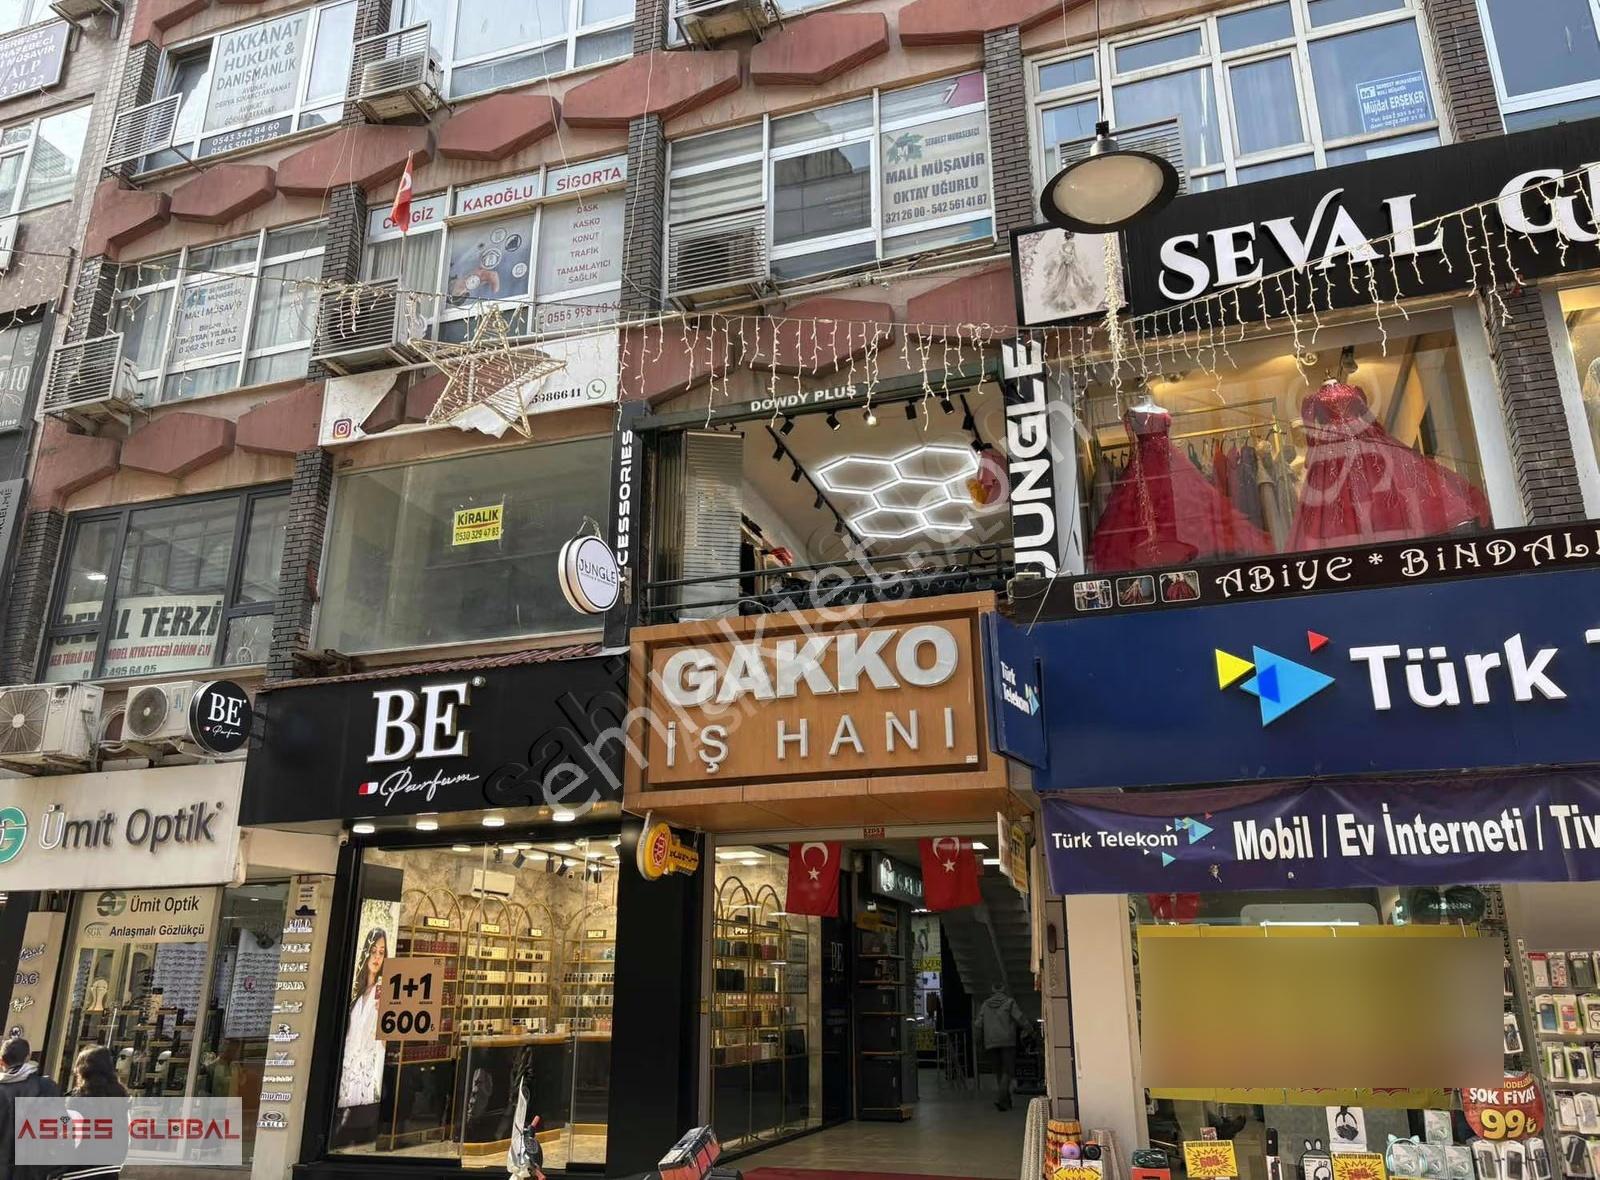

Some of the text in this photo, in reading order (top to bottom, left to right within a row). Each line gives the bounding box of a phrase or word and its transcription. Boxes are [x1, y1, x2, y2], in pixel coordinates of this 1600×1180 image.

[223, 19, 302, 56] AKKANAT
[224, 42, 295, 72] HUKUK &
[886, 152, 985, 185] MALİ MÜŞAVİR
[383, 167, 621, 229] CGİZ KAROĞLU SİGORTA
[893, 176, 978, 204] OKTAY UĞURLU
[573, 218, 600, 229] KASKO
[886, 212, 900, 223] 321
[901, 209, 912, 220] 26
[931, 202, 948, 214] 542
[570, 247, 599, 258] TRAFİK
[573, 232, 599, 244] KONUT
[1157, 187, 1443, 302] SEVAL
[557, 260, 611, 276] TAMAMLAYICI
[751, 385, 857, 412] DOWDY PLUS
[1002, 341, 1058, 578] JUNGLE
[616, 429, 633, 574] CESSORIES
[579, 558, 616, 584] JUNGLE
[141, 601, 224, 638] TERZİ
[661, 624, 959, 708] GAKKO
[1348, 632, 1567, 711] Türk
[208, 692, 243, 727] BE
[366, 681, 473, 763] BE
[665, 706, 955, 775] İŞ HANI
[39, 801, 215, 853] Ümit Optik
[1052, 833, 1092, 849] Türk
[1097, 831, 1178, 848] Telekom
[1233, 816, 1314, 861] Mobil
[1336, 814, 1375, 857] Ev
[1381, 803, 1528, 856] İnterneti
[130, 895, 200, 914] Ümit Optik
[109, 925, 156, 938] Anlaşmalı
[159, 923, 205, 937] Gözlükçü
[390, 973, 432, 1000] 1+1
[1469, 1086, 1535, 1104] ŞOK FİYAT
